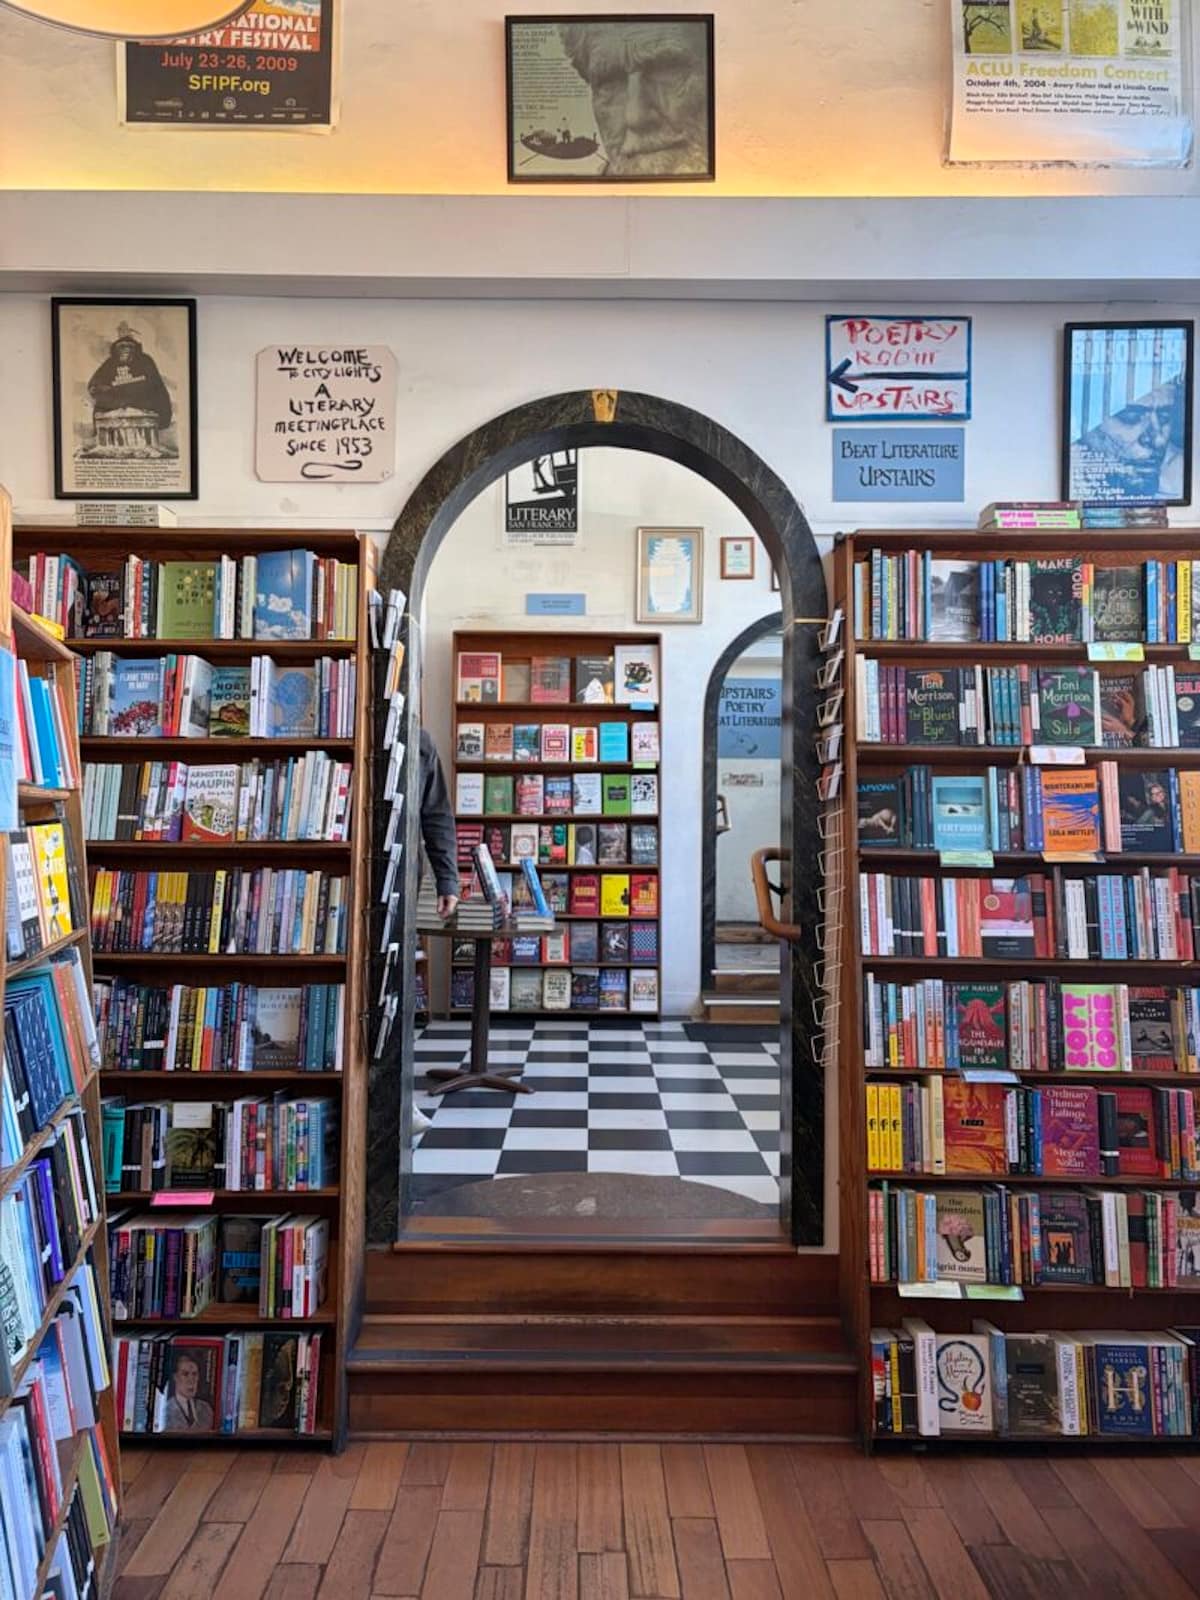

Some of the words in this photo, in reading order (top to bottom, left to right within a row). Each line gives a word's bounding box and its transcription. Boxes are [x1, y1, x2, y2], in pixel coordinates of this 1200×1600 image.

[1131, 6, 1164, 20] WITH
[227, 14, 317, 33] ATIONAL
[1134, 21, 1169, 35] WIND
[230, 31, 313, 50] FESTIVAL
[160, 52, 193, 71] July
[199, 53, 250, 70] 23-26,
[256, 56, 298, 71] 2009
[966, 61, 1013, 76] ACLU
[1020, 62, 1097, 79] Freedom
[1103, 63, 1169, 82] Concert
[188, 75, 270, 95] SFIPF.org
[966, 79, 1000, 88] October
[1023, 80, 1046, 88] 2004
[843, 320, 957, 345] POETRY
[278, 348, 372, 366] WELCOME
[855, 348, 937, 366] ROOM
[303, 368, 331, 380] CITY
[333, 366, 382, 382] LIGHTS
[315, 383, 331, 399] A
[289, 398, 375, 417] LITERARY
[837, 387, 959, 415] UPSTAIRS
[275, 417, 385, 434] MEETINGPLACE
[286, 439, 326, 456] SINCE
[336, 437, 373, 456] 1953
[841, 441, 878, 459] BEAT
[859, 466, 936, 488] UPSTAIRS
[508, 507, 576, 521] LITERARY
[508, 521, 525, 529] SAN
[526, 521, 576, 529] FRANCISCO
[1037, 558, 1073, 570] MAKE
[1072, 567, 1082, 599] YOUR
[1109, 588, 1139, 600] GOD
[1094, 614, 1139, 625] WOODS
[1034, 634, 1074, 644] HOME
[1051, 674, 1080, 690] Toni
[214, 693, 250, 701] WOOD
[907, 688, 956, 706] Morrison
[1043, 688, 1091, 706] Morrison
[725, 700, 767, 712] POETRY
[732, 714, 781, 727] LITERATUR
[922, 707, 956, 721] Bluest
[923, 725, 944, 739] Eye
[1052, 720, 1081, 735] Sula
[191, 770, 235, 778] ARMISTEAD
[189, 779, 235, 789] MAUPIN
[971, 1030, 986, 1039] THE
[962, 1055, 977, 1064] THE
[980, 1055, 997, 1064] SEA
[1046, 1089, 1089, 1101] Ordinary
[1050, 1099, 1086, 1109] Human
[1050, 1107, 1087, 1118] Failings
[1054, 1148, 1087, 1160] Megan
[1056, 1157, 1085, 1168] Nolan
[949, 1199, 963, 1207] The
[936, 1262, 957, 1275] igrid
